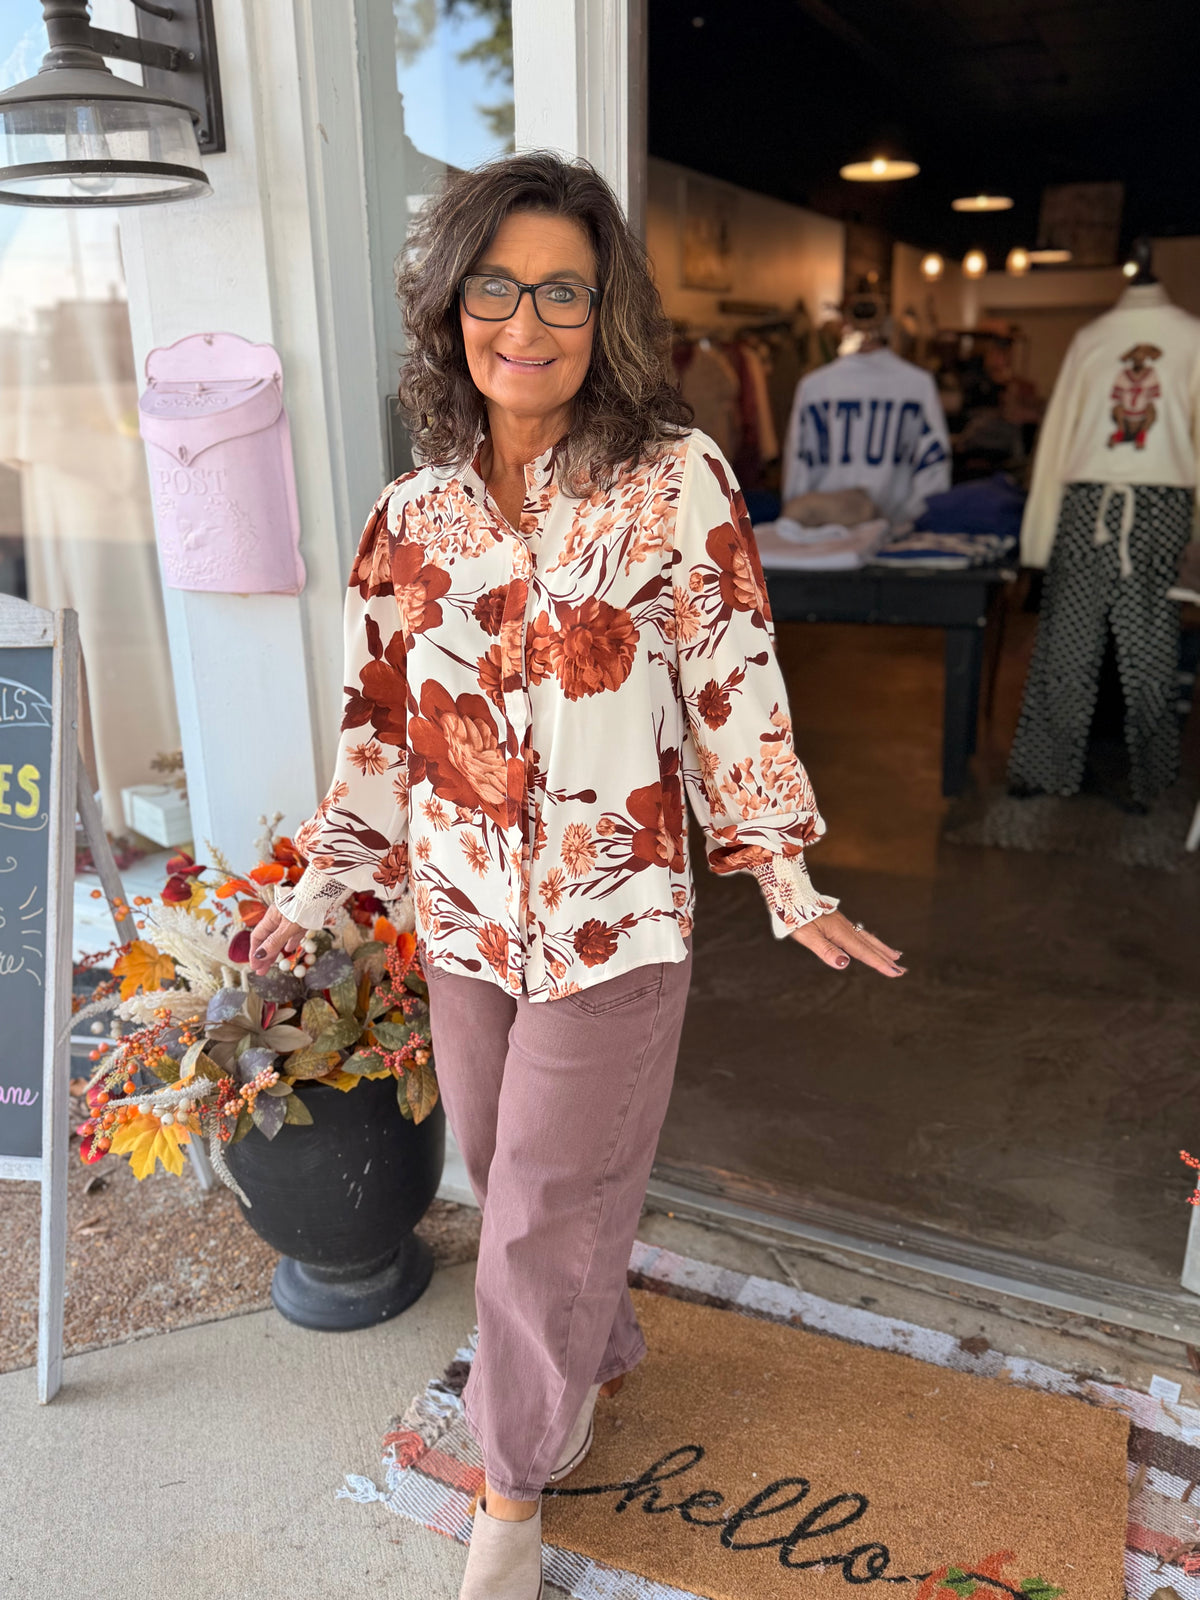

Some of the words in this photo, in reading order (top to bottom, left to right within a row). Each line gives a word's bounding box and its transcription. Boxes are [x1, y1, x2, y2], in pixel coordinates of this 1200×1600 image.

[157, 468, 228, 498] POST
[0, 687, 28, 721] LS
[585, 1444, 898, 1584] hello
